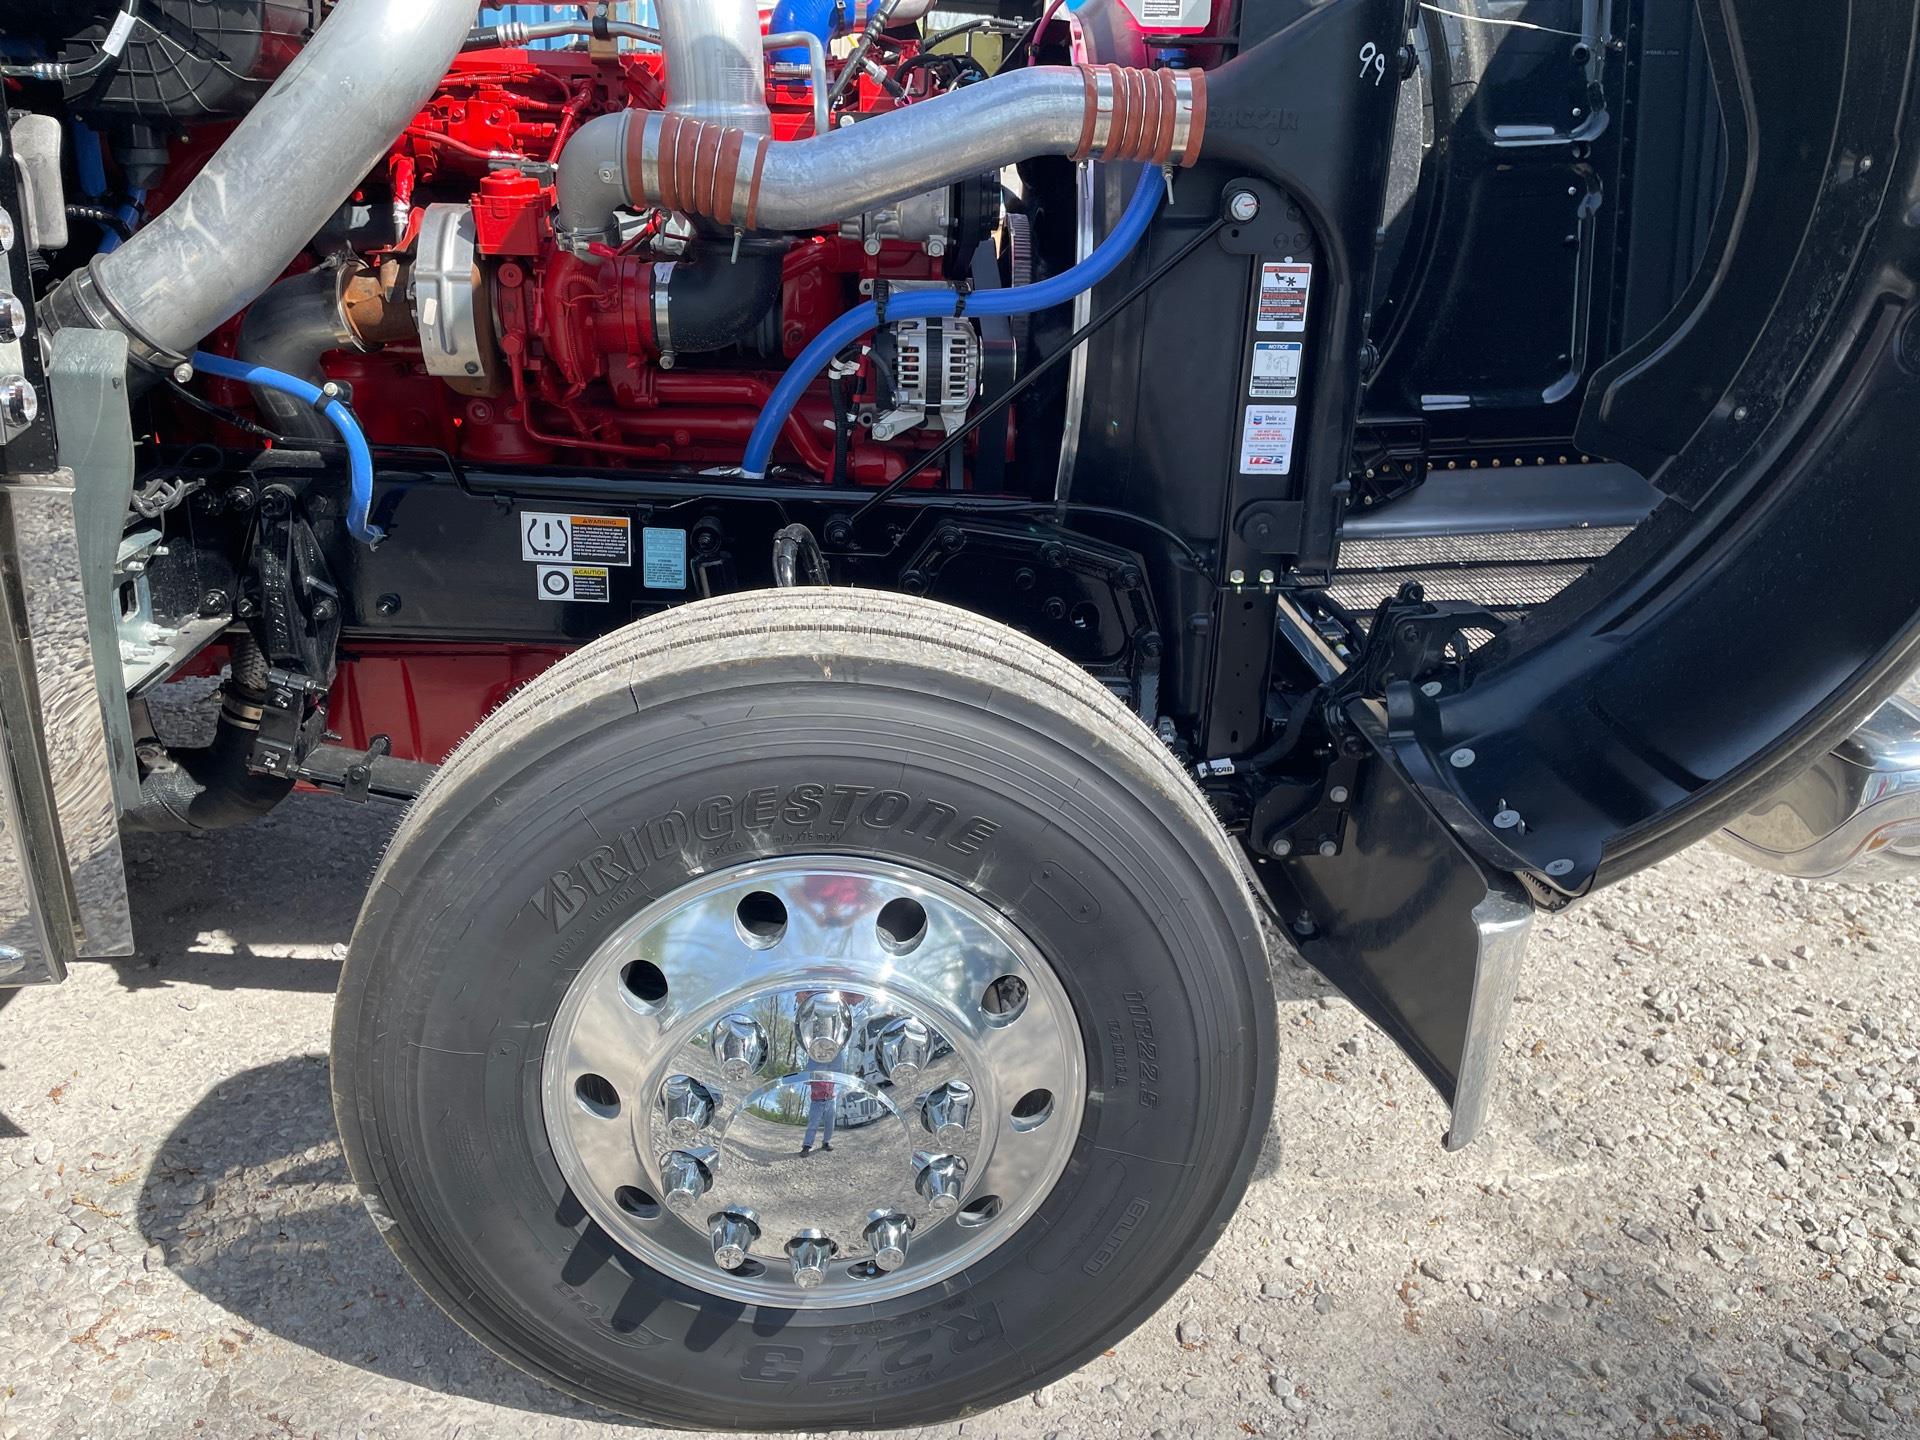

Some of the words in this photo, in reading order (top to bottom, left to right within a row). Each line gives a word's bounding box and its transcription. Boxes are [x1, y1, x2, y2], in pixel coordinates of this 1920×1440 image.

[1359, 41, 1386, 86] 99
[1249, 456, 1284, 464] TRP
[527, 782, 1004, 934] BRIDGESTONE
[1122, 990, 1160, 1110] 11R22.5
[1084, 1199, 1150, 1276] ENLITEN
[741, 1301, 1006, 1386] R273
